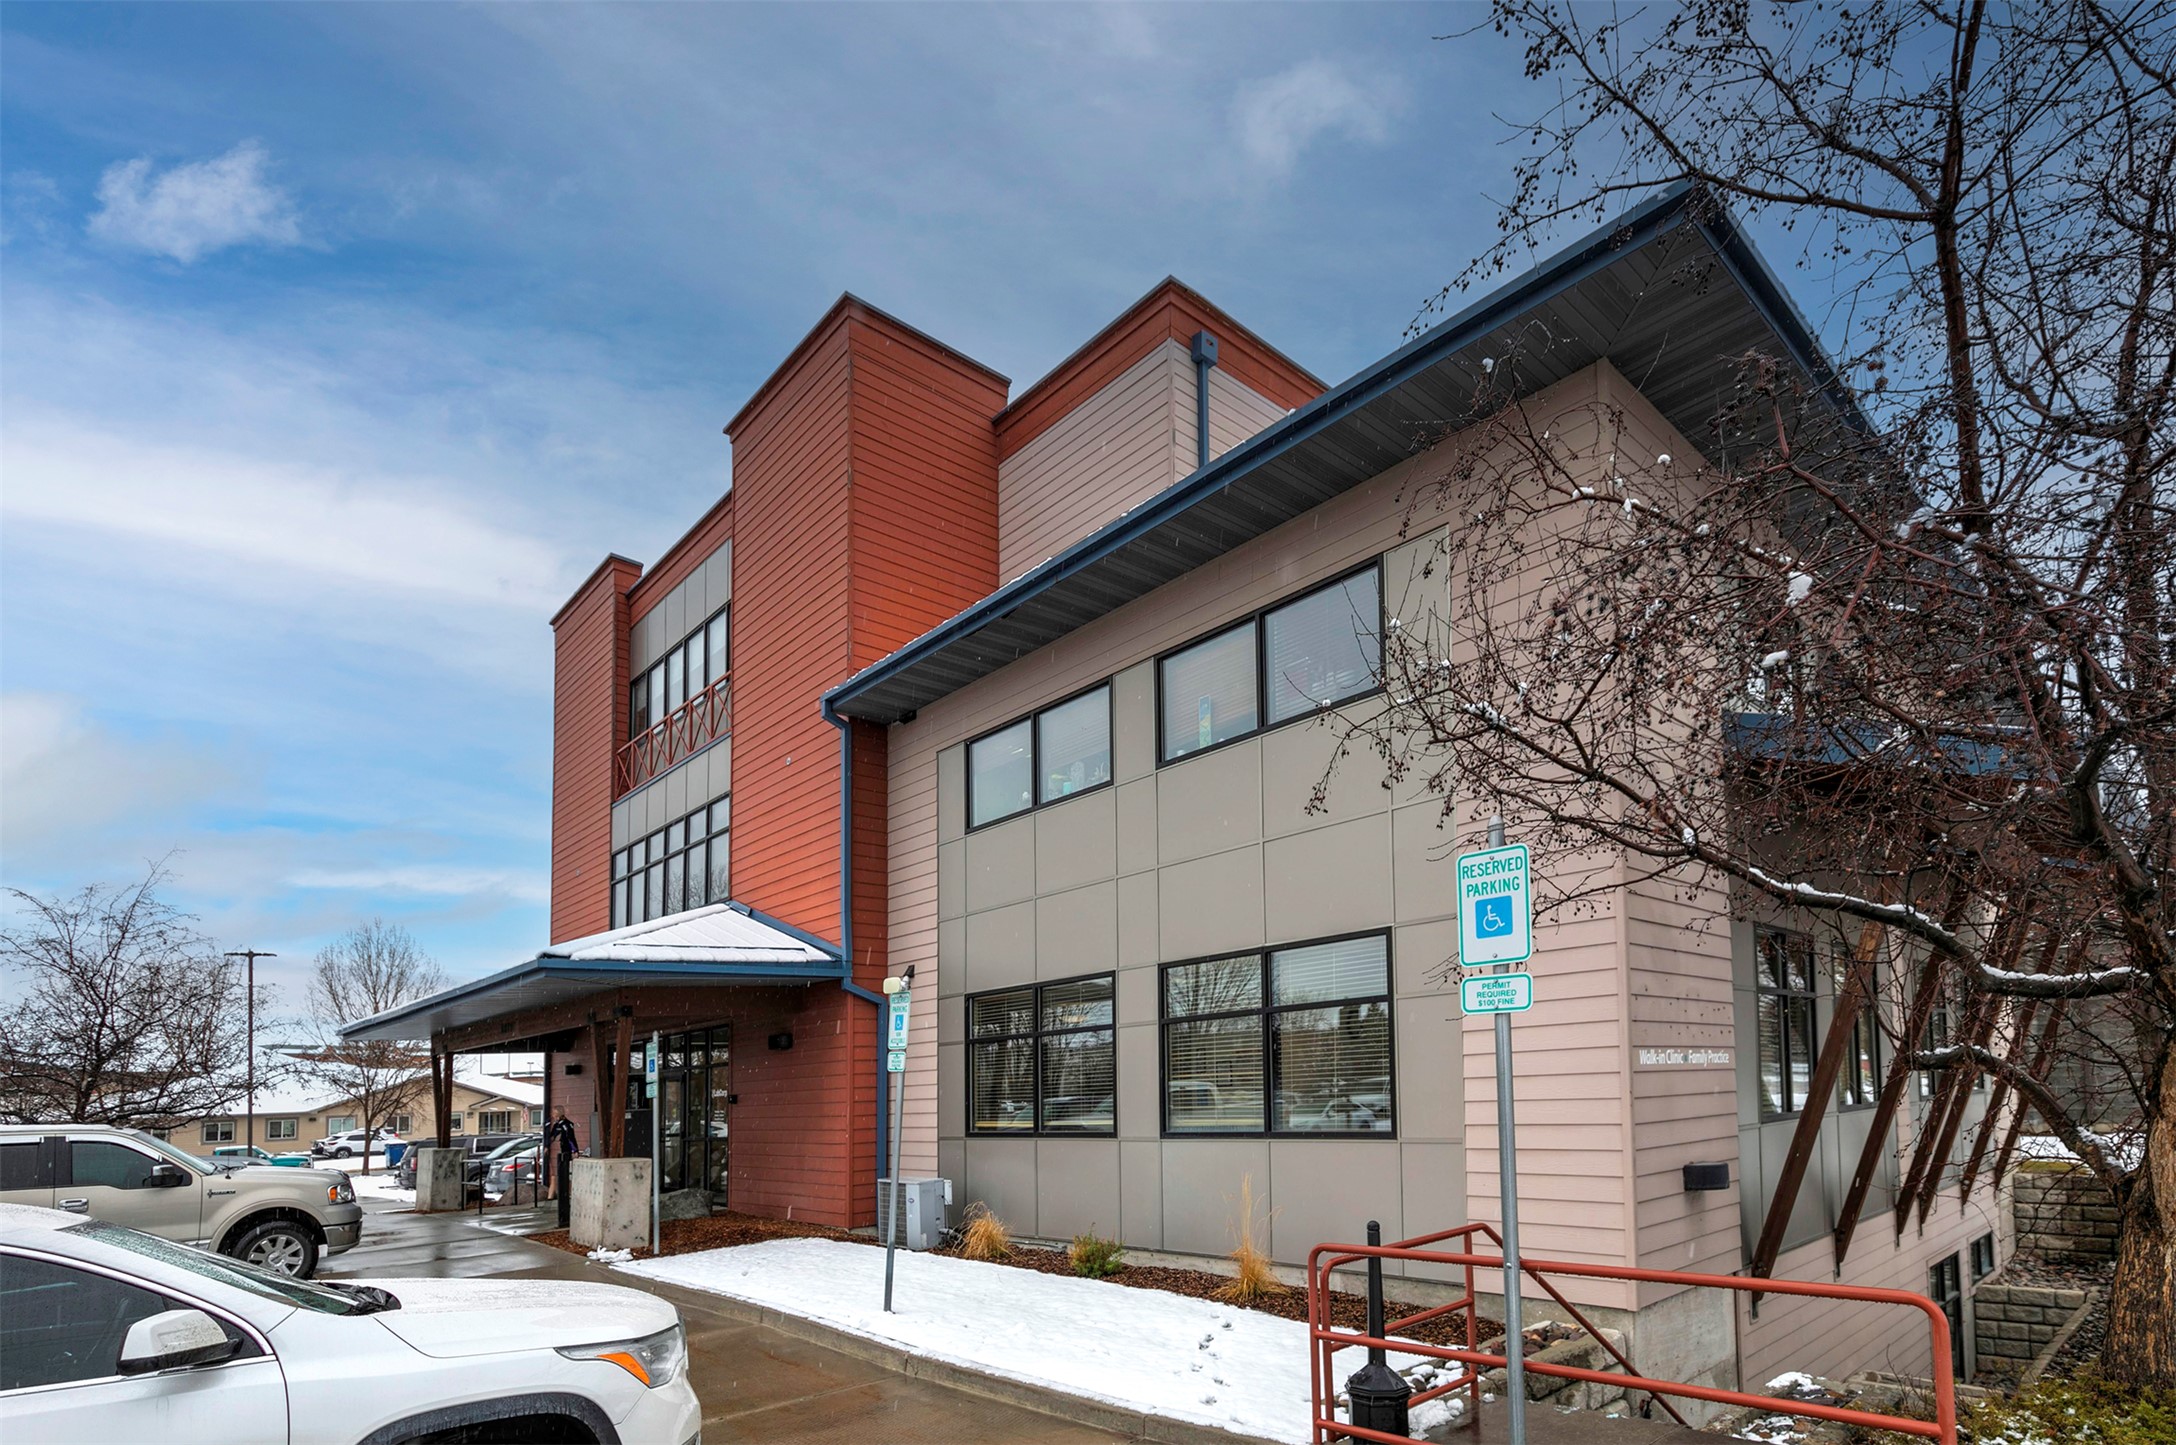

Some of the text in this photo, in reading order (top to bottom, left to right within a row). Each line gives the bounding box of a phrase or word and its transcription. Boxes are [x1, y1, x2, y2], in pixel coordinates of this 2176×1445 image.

[1462, 856, 1523, 879] RESERVED
[1466, 876, 1520, 898] PARKING
[1476, 989, 1517, 999] REQUIRED
[1482, 981, 1511, 990] PERMIT
[1639, 1049, 1729, 1067] Walk-in Clinic Family Practice
